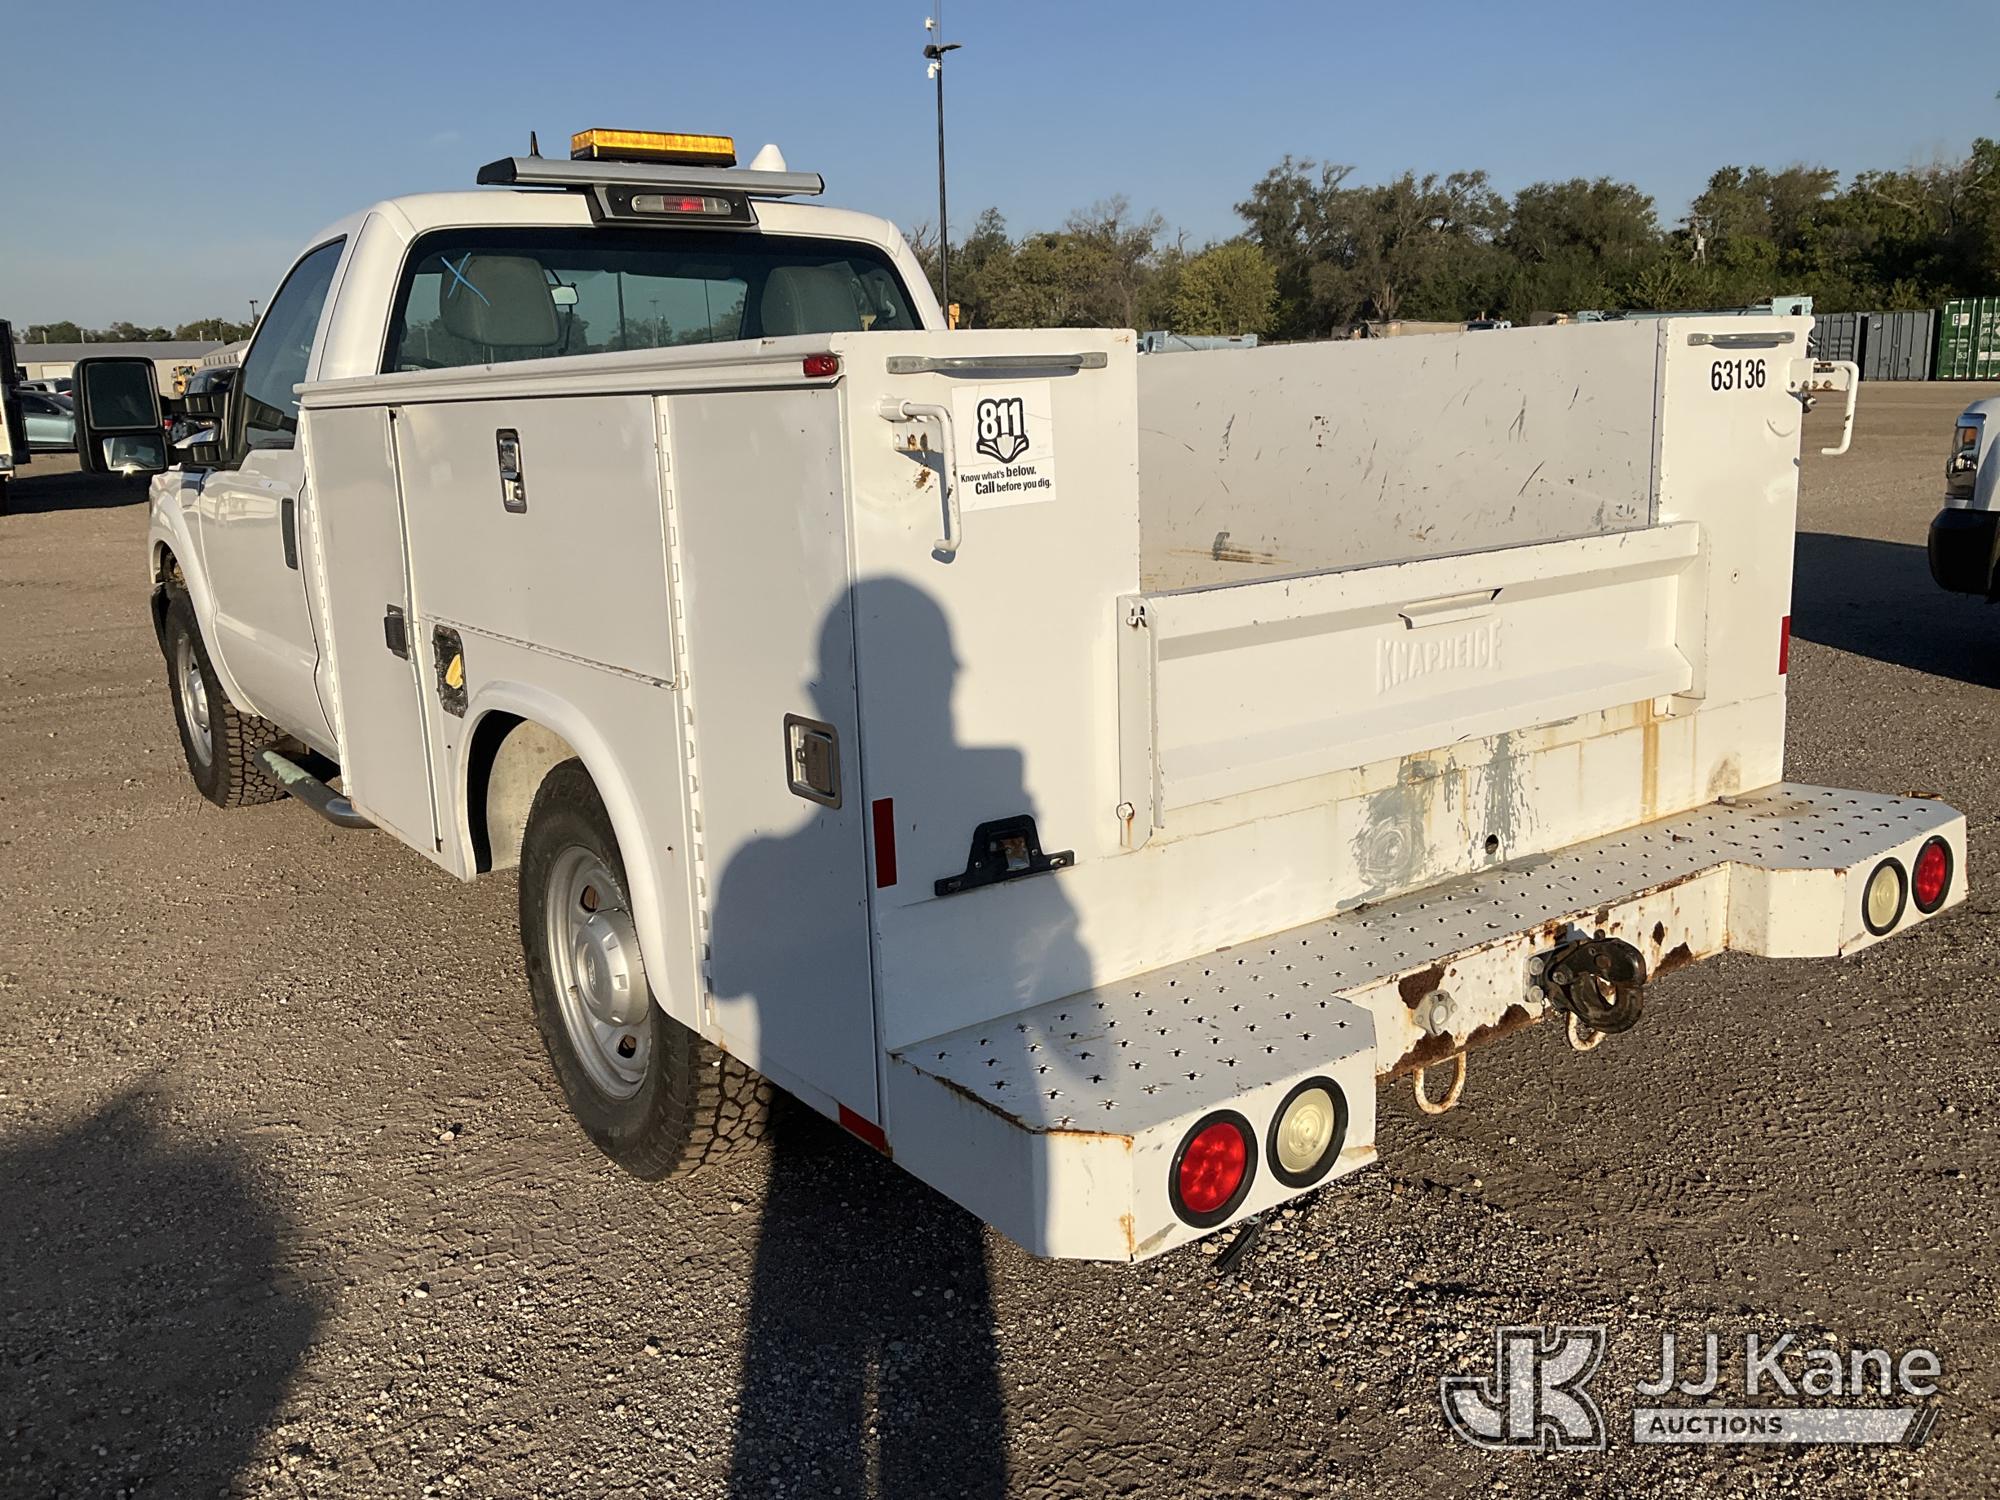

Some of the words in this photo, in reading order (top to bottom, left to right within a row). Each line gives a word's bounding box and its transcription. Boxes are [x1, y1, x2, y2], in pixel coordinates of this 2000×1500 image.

[1711, 359, 1766, 391] 63136
[977, 397, 1024, 440] 811
[960, 473, 981, 483] Know
[982, 470, 1005, 481] what's
[1006, 466, 1037, 477] below.
[975, 481, 995, 495] Call
[996, 482, 1022, 492] before
[1023, 480, 1037, 491] you
[1038, 478, 1051, 488] dig.
[1375, 617, 1503, 696] KNAPHEIDE
